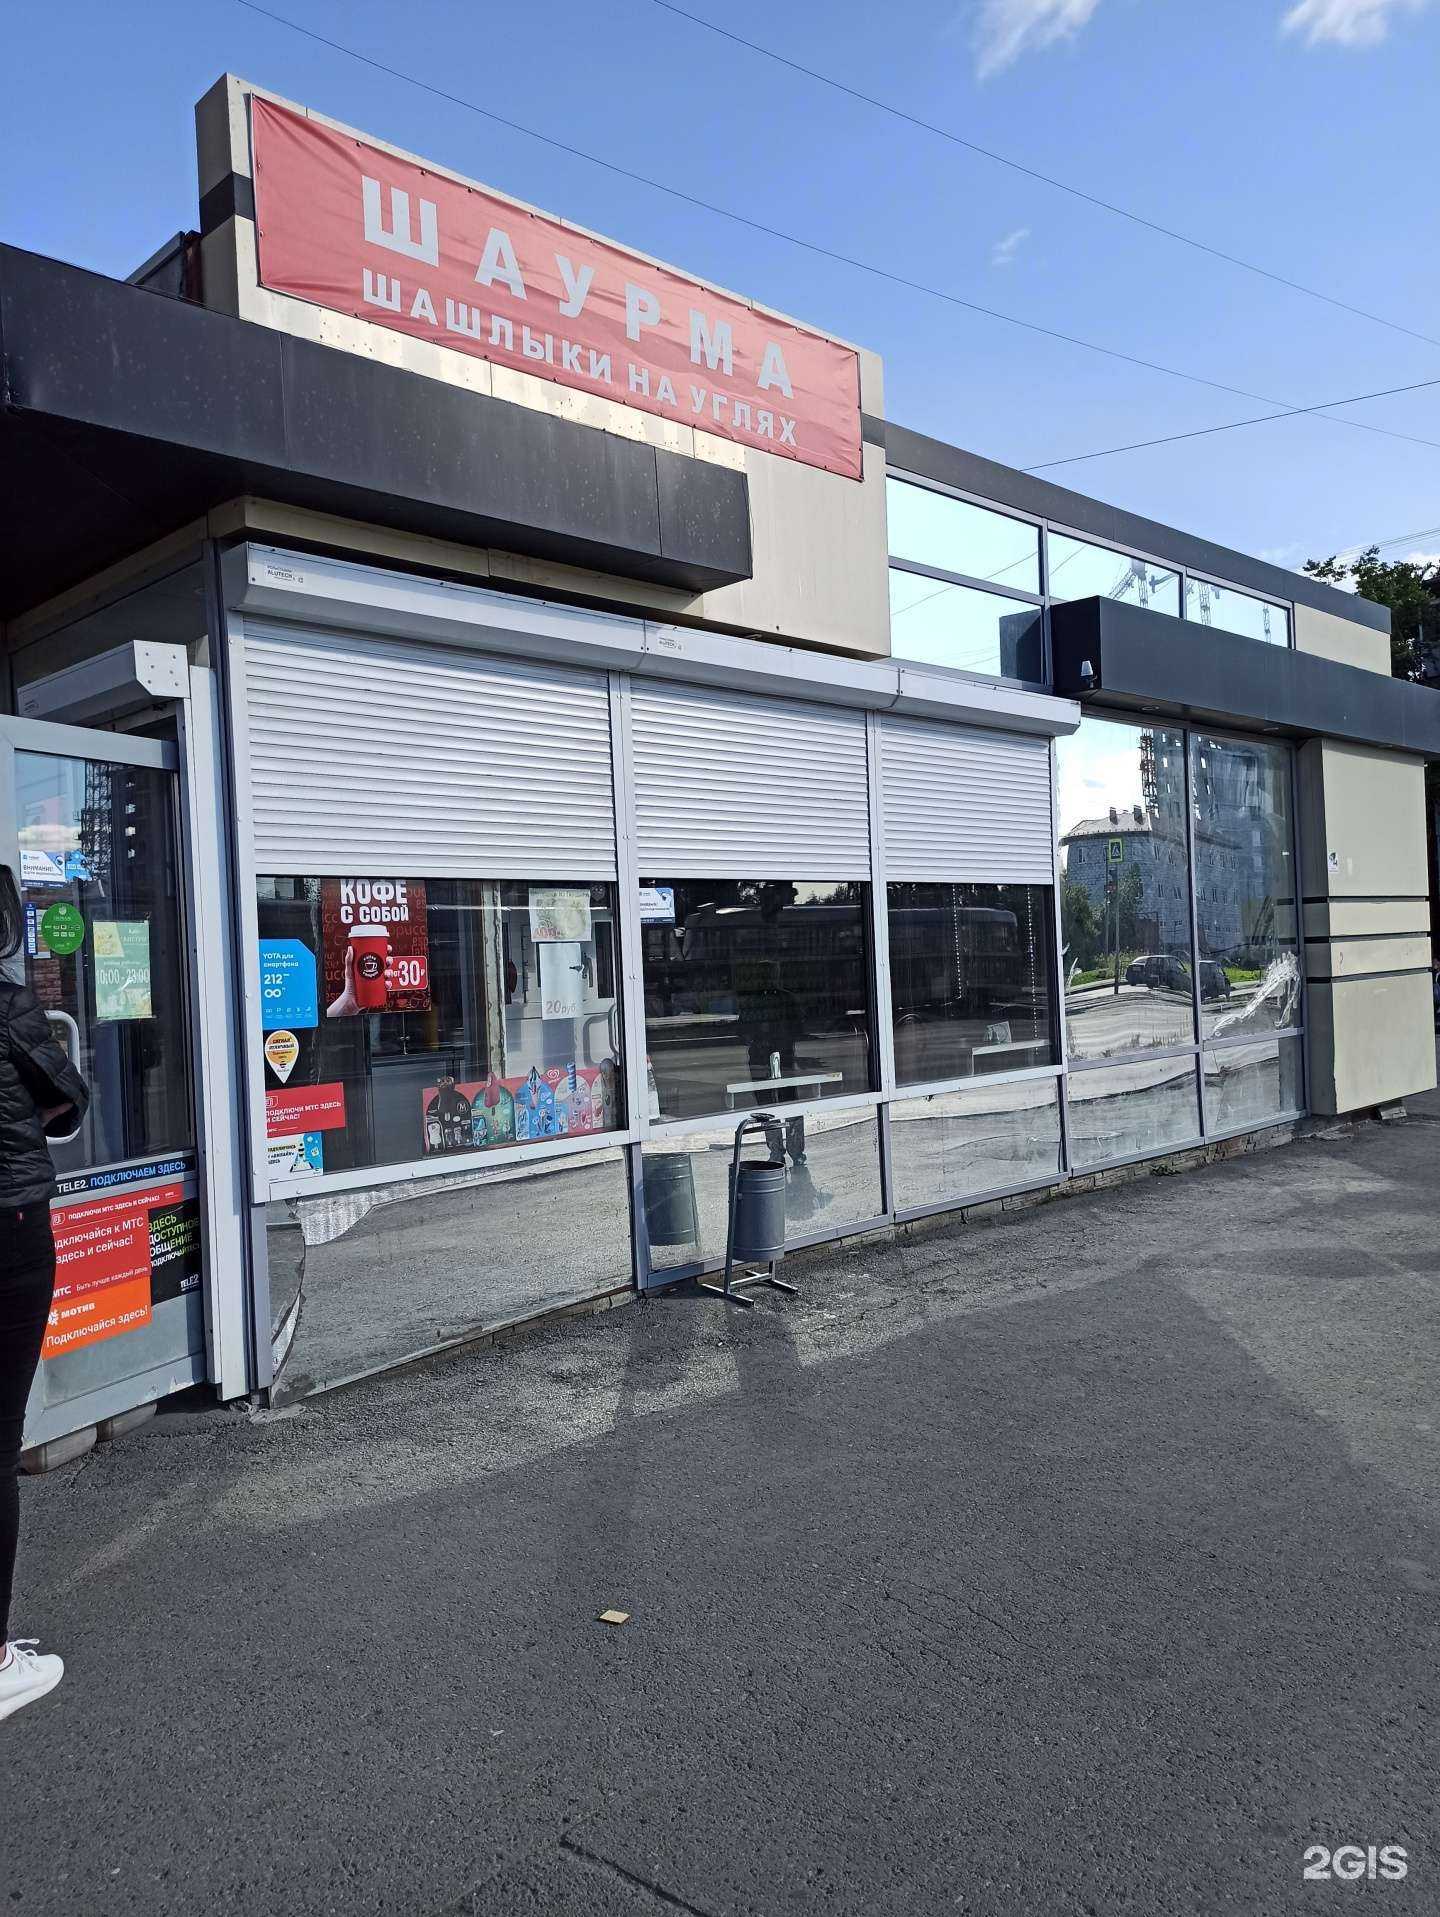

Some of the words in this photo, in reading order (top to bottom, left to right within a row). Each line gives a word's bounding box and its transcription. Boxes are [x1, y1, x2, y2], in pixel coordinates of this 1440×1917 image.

[361, 175, 795, 399] ШАУРМА
[362, 267, 613, 385] ШАШЛЫКИ
[628, 363, 678, 407] НА
[690, 385, 798, 448] УГЛЯХ
[340, 879, 408, 905] КОФЕ
[340, 905, 354, 924] С
[359, 904, 409, 923] СОБОЙ
[264, 973, 283, 985] 212
[398, 960, 420, 986] 30
[320, 1101, 342, 1110] ЗДЕСЬ
[90, 1167, 156, 1187] ПОДКЛЮЧАЕМ
[157, 1161, 186, 1175] ЗДЕСЬ
[68, 1207, 102, 1220] ПОДКЛЮЧИ
[102, 1204, 114, 1213] МТС
[114, 1201, 133, 1211] ЗДЕСЬ
[148, 1214, 177, 1233] ЗДЕСЬ
[54, 1227, 112, 1250] дключайся
[122, 1216, 144, 1231] МТС
[149, 1232, 193, 1257] ОБЩЕНИЕ
[56, 1250, 85, 1265] здесь
[87, 1247, 94, 1256] и
[96, 1235, 134, 1254] сейчас!
[46, 1319, 116, 1348] Подключайся
[117, 1304, 149, 1324] здесь!
